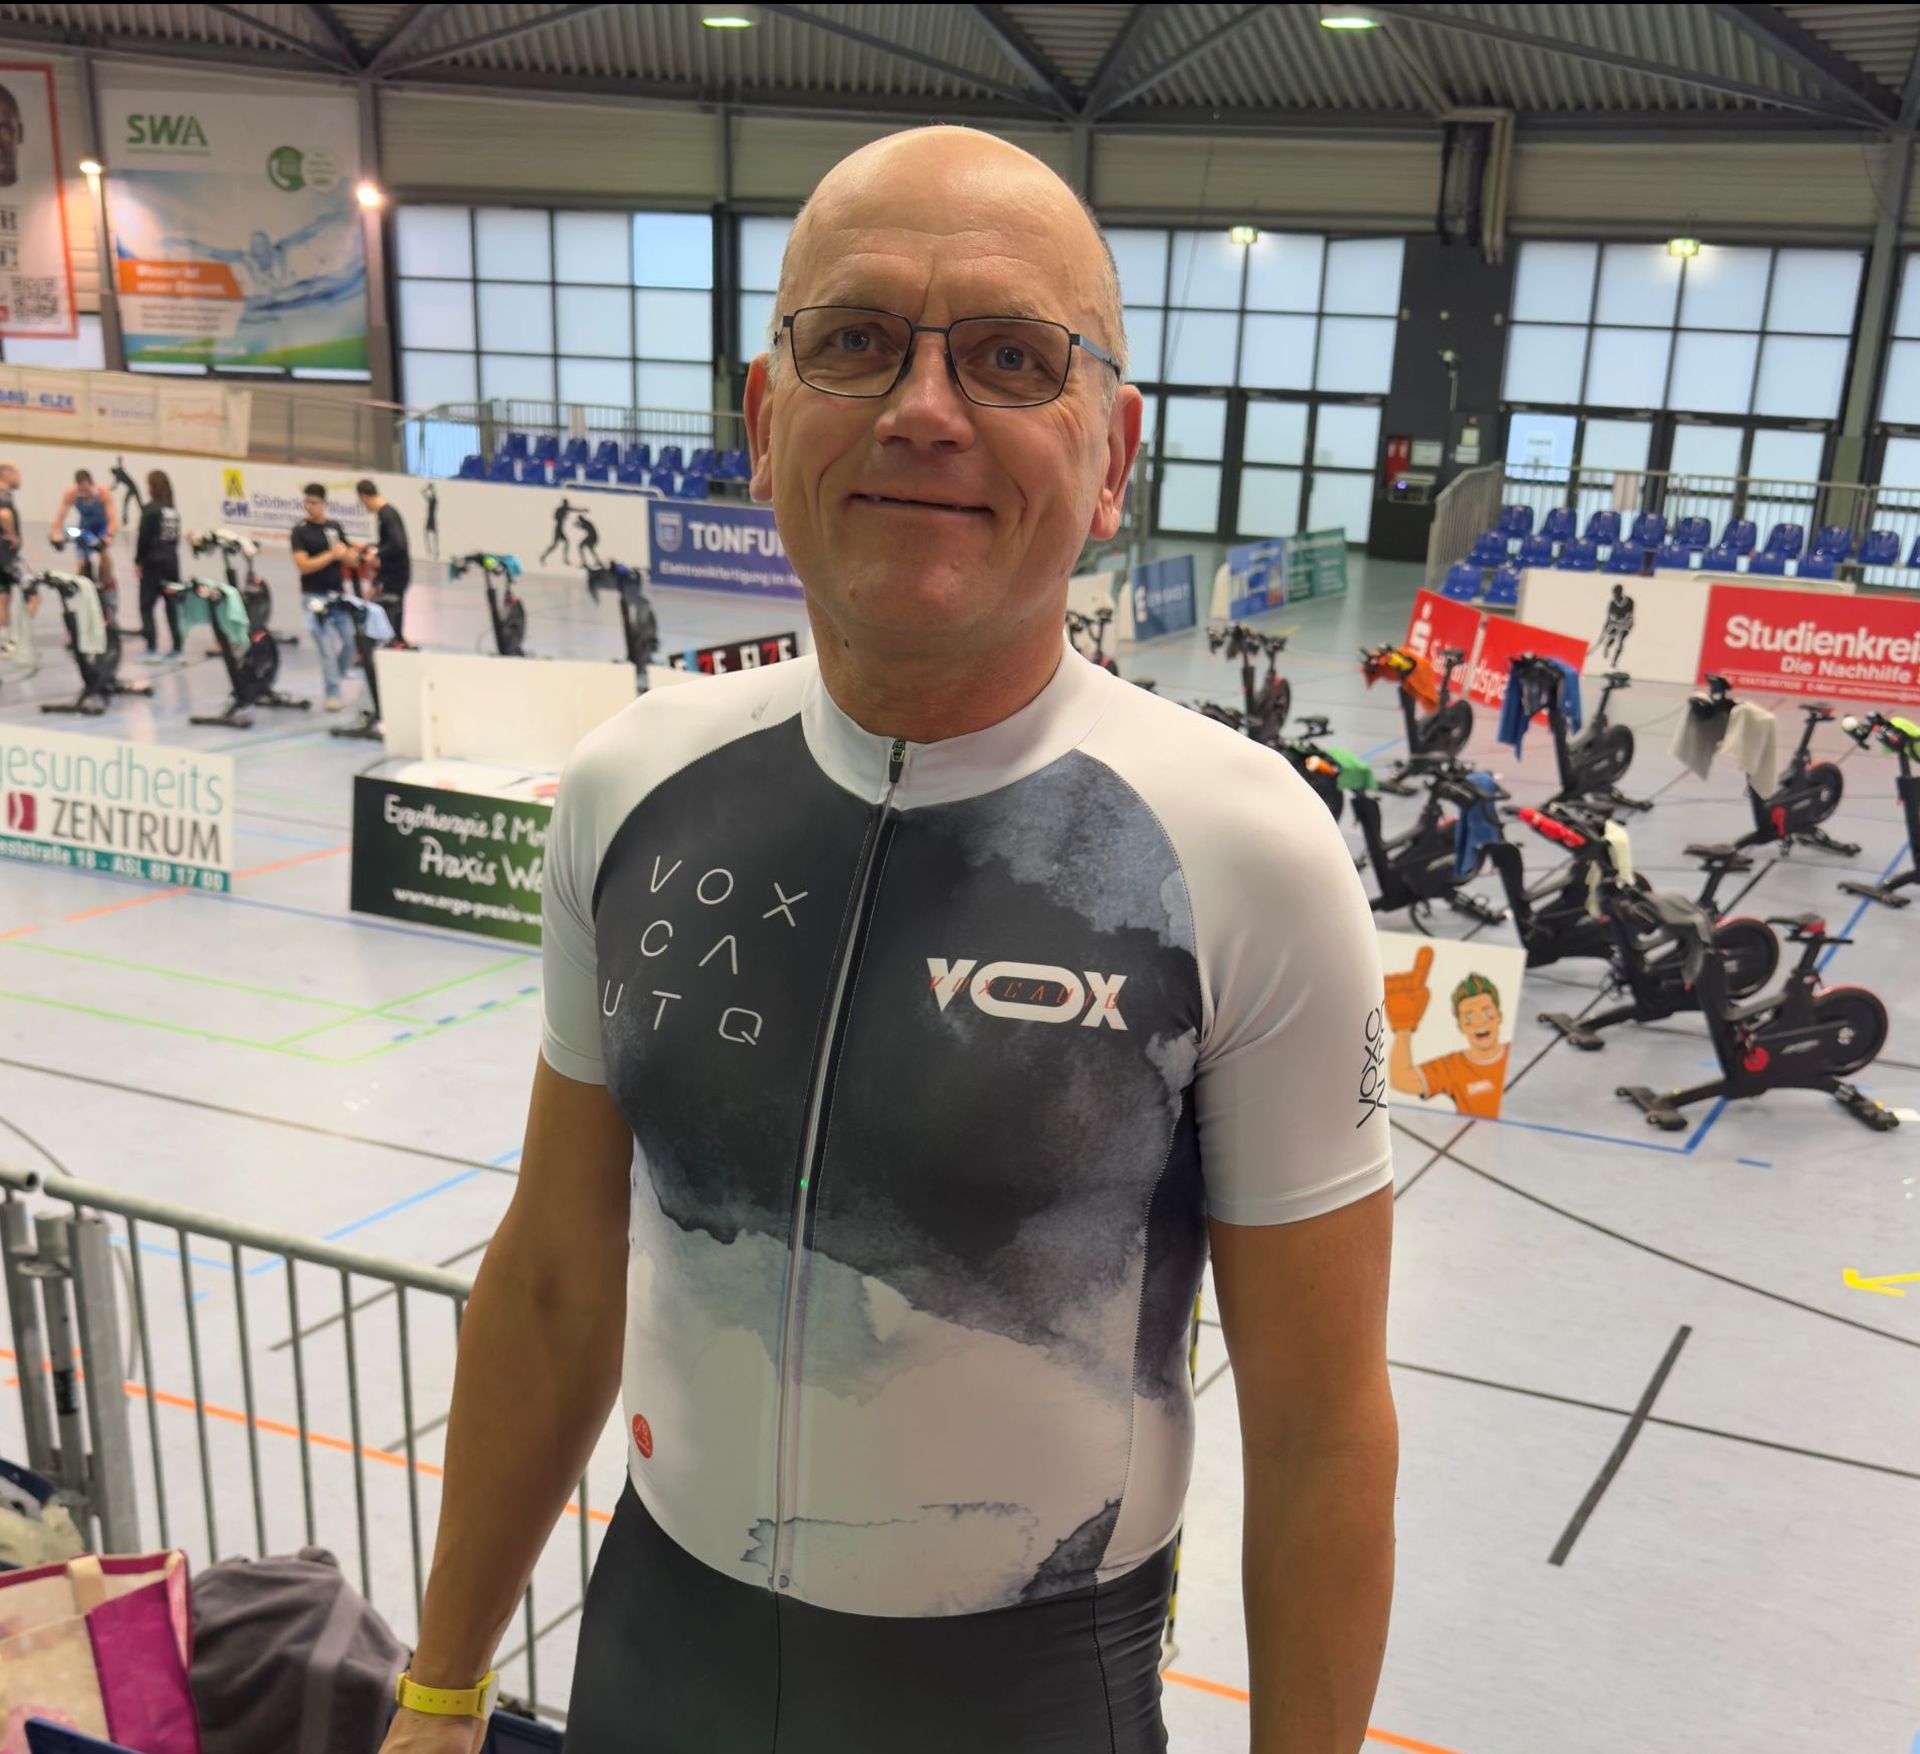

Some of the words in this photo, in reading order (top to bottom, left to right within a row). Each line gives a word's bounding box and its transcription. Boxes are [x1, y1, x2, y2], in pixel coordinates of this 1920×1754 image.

[126, 113, 209, 147] SWA
[1724, 614, 1920, 665] Studienkrei
[1780, 656, 1814, 676] Die
[1818, 659, 1912, 685] Nachhilfe
[0, 745, 224, 816] esundheits
[51, 797, 222, 864] ZENTRUM
[383, 793, 490, 846] Ergotherapie
[113, 856, 145, 878] ASL
[419, 835, 497, 886] Praxis
[650, 855, 809, 928] VOX
[926, 957, 1129, 1031] VOX
